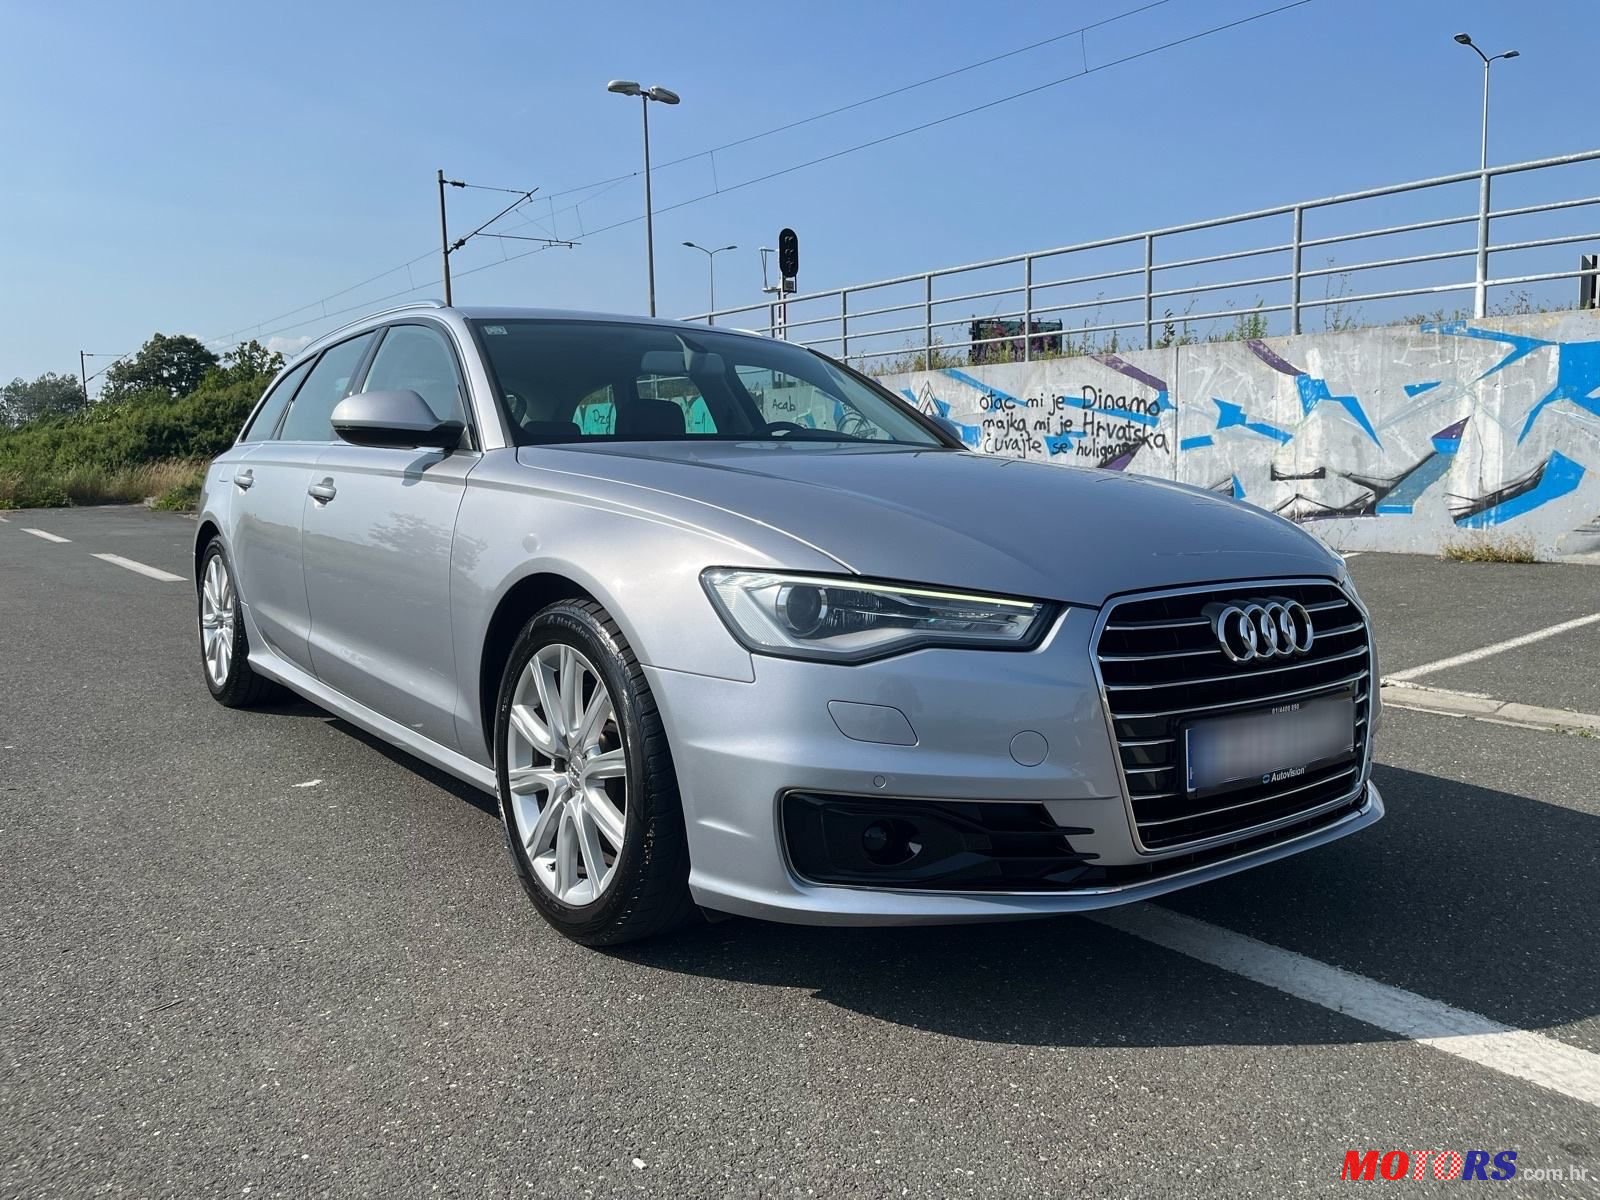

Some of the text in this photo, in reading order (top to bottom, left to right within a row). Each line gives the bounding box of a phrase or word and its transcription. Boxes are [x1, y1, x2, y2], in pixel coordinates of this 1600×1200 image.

[979, 385, 1161, 417] otac mi je Dinamo
[982, 412, 1170, 454] majka mi je Hrvatska
[1052, 441, 1069, 454] se
